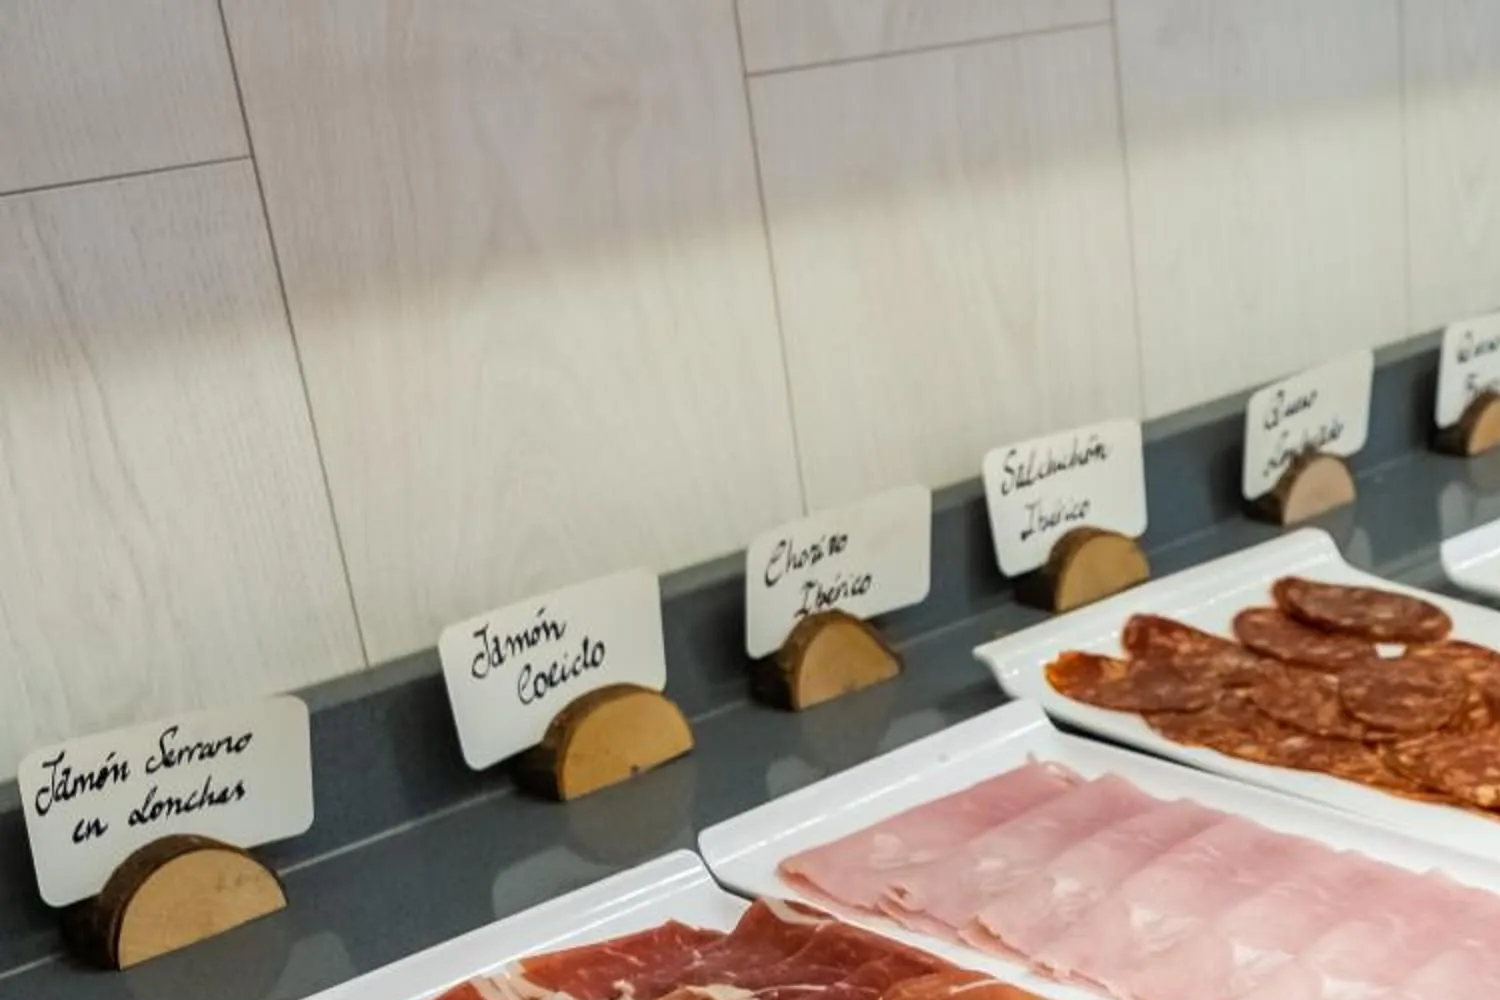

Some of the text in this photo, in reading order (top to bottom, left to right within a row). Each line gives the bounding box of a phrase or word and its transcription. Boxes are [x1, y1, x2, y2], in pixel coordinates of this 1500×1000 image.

[471, 606, 566, 679] Jamón
[35, 725, 253, 816] Jamón Serrano
[72, 775, 246, 844] en Lonchas
